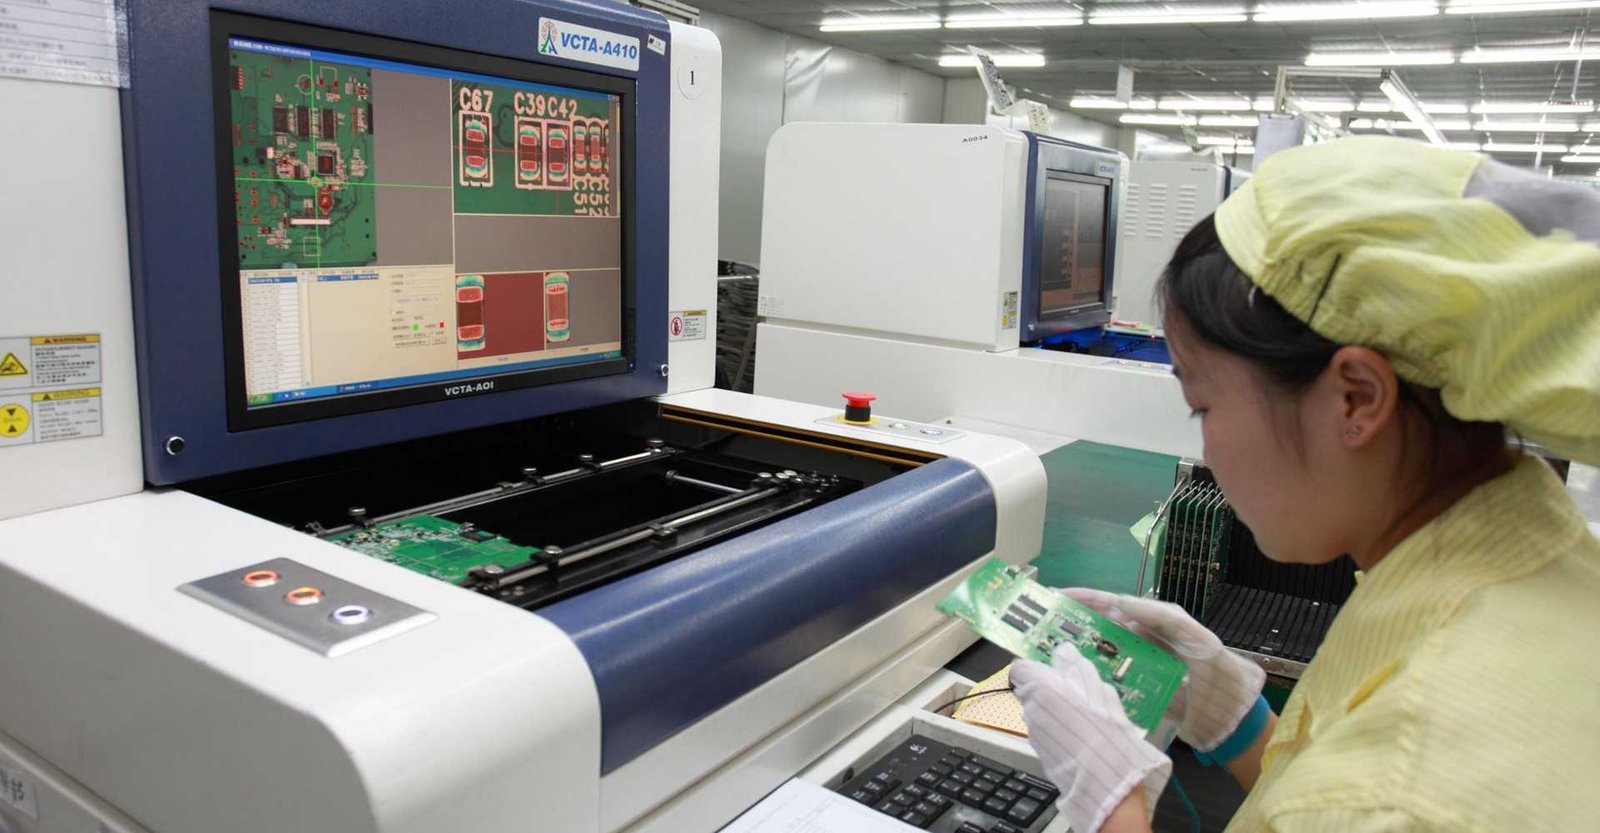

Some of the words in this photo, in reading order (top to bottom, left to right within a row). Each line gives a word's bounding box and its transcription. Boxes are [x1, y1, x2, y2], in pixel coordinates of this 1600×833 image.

[560, 31, 638, 60] VCTA-A410
[690, 70, 695, 86] 1
[459, 86, 494, 113] C67
[514, 91, 546, 116] C39
[547, 96, 578, 120] C42
[574, 177, 588, 214] C51
[589, 178, 603, 217] C52
[444, 381, 495, 396] VCTA-AOI
